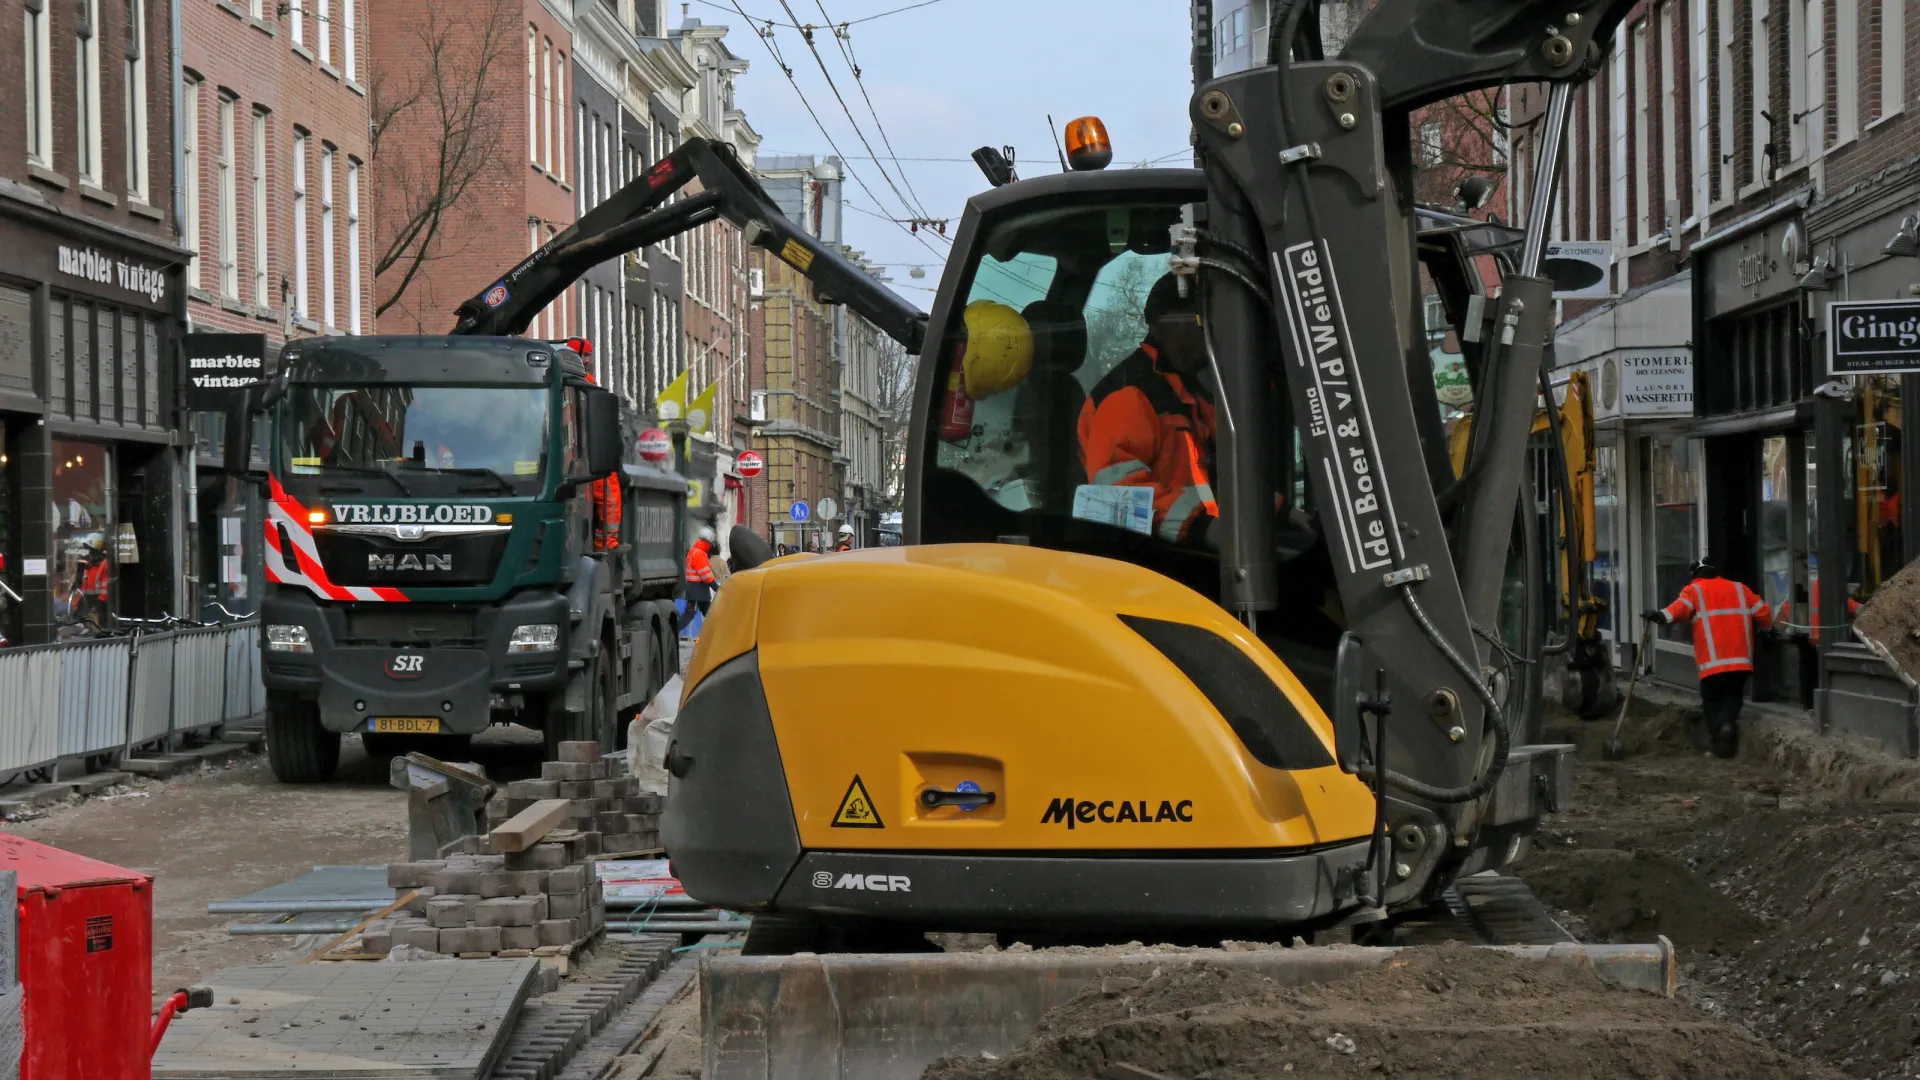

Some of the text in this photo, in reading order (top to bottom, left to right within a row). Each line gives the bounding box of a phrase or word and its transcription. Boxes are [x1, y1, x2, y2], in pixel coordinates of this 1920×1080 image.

[1546, 246, 1604, 255] tte-STOMERIJ
[58, 245, 164, 303] marbles vintage
[511, 258, 535, 281] power
[487, 288, 505, 305] HMF
[190, 354, 261, 369] marbles
[1651, 367, 1685, 375] CLEANING
[1319, 357, 1352, 411] v/d
[1306, 386, 1327, 438] Firma
[1337, 416, 1360, 438] &
[1348, 446, 1379, 515] Boer
[331, 505, 493, 524] VRIJBLOED
[1364, 519, 1390, 557] de
[368, 553, 453, 571] MAN
[392, 654, 424, 671] SR
[380, 719, 434, 731] 81-BDL-7
[1040, 797, 1193, 830] MeCALAC
[812, 871, 912, 892] 8 MCR
